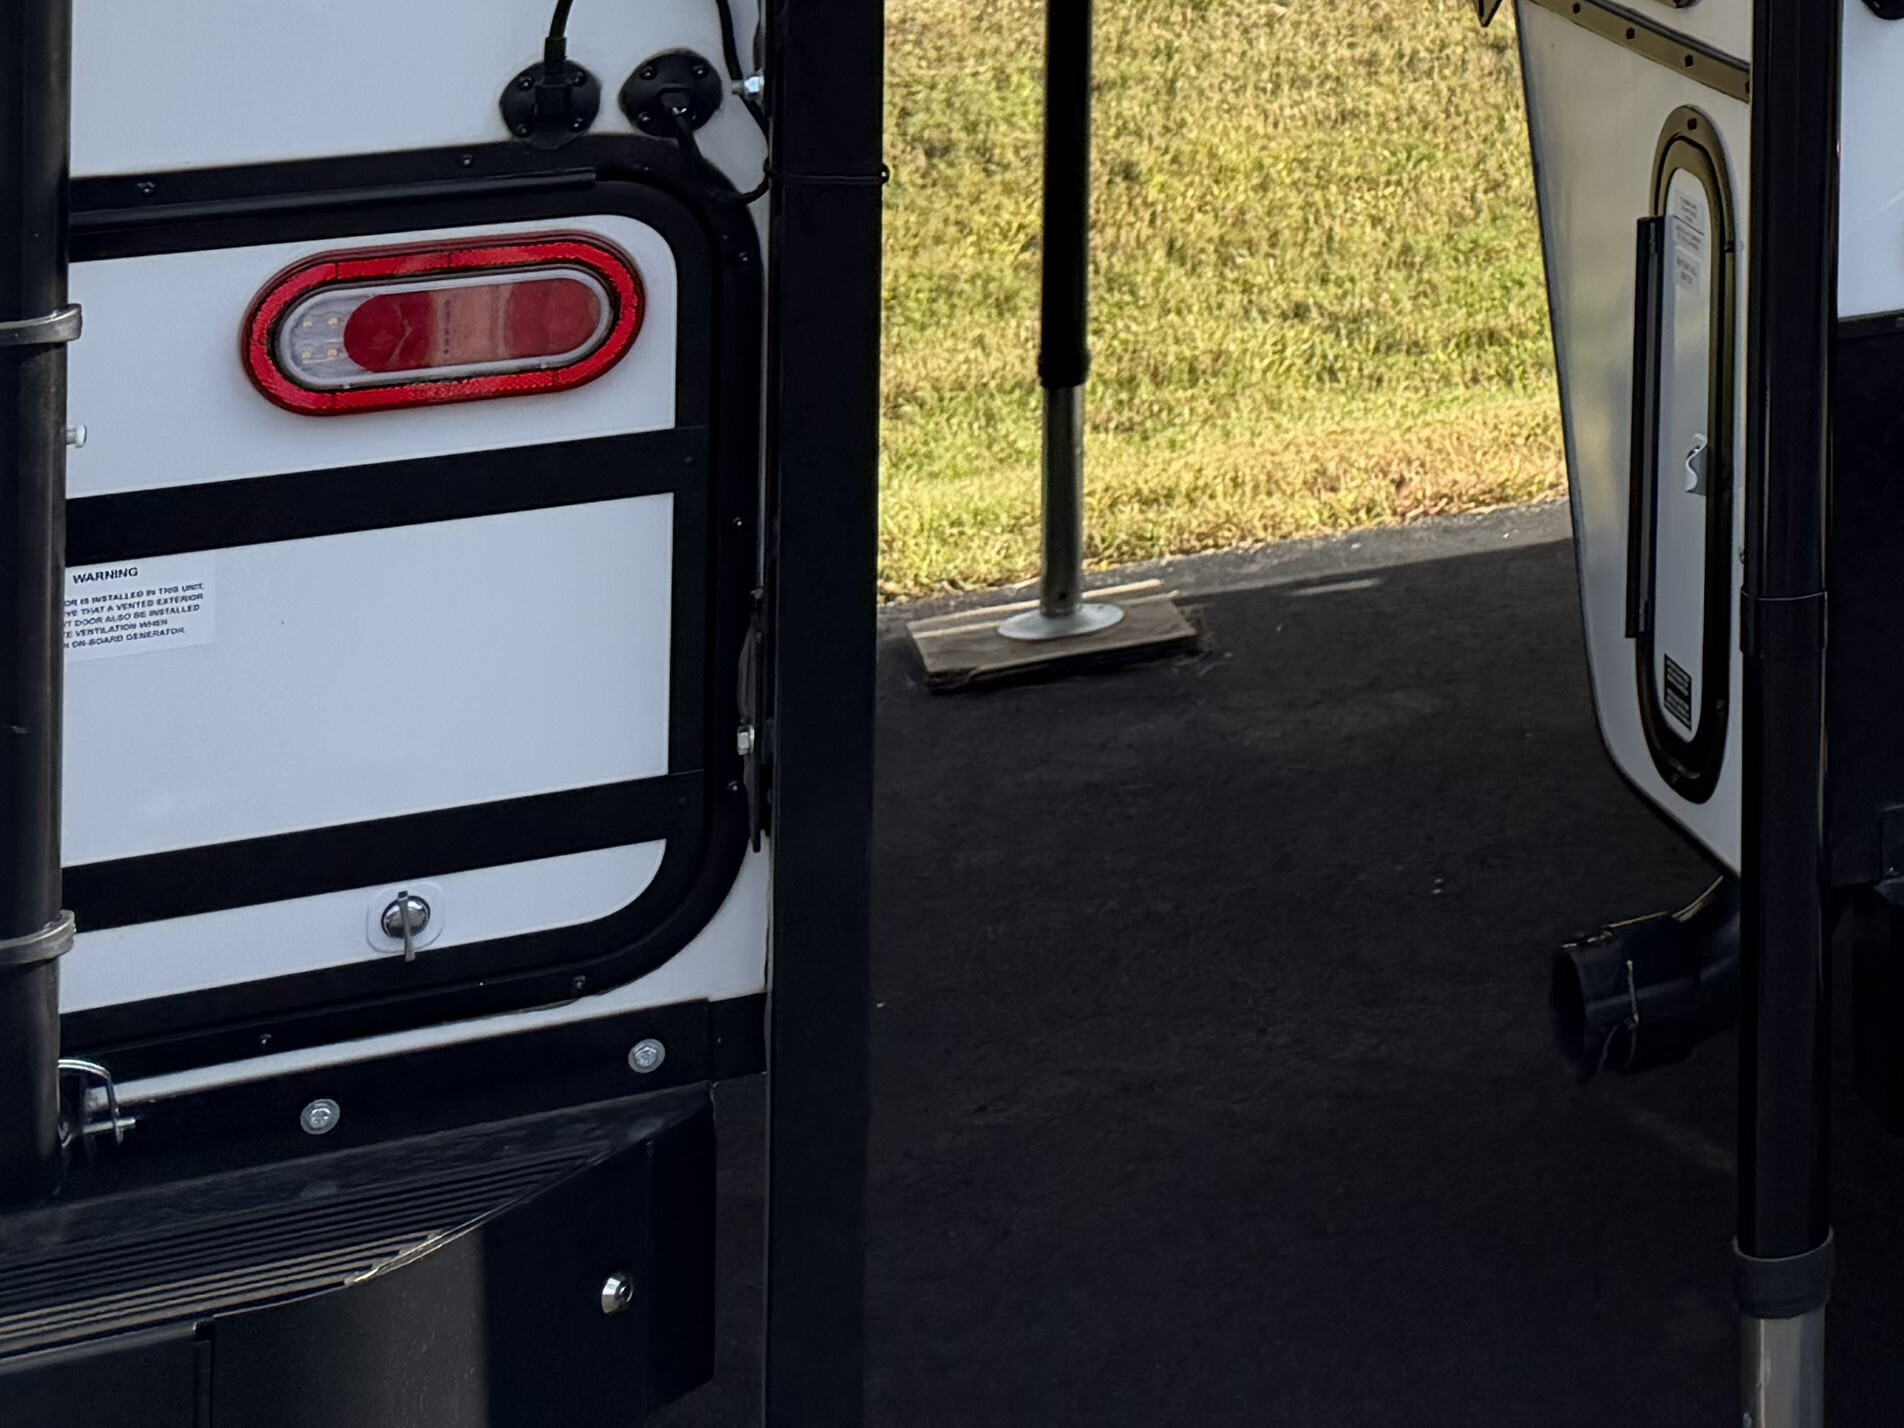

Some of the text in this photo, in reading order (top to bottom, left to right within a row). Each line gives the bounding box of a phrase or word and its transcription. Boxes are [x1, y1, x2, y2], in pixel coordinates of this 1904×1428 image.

[73, 567, 139, 584] WARNING
[81, 606, 104, 616] THAT
[116, 599, 154, 611] VENTED
[156, 593, 204, 606] EXTERIOR
[92, 591, 144, 604] INSTALLED
[75, 617, 103, 627] DOOR
[105, 613, 131, 623] ALSO
[149, 603, 200, 617] INSTALLED
[75, 624, 137, 637] VENTILATION
[139, 619, 168, 629] WHEN
